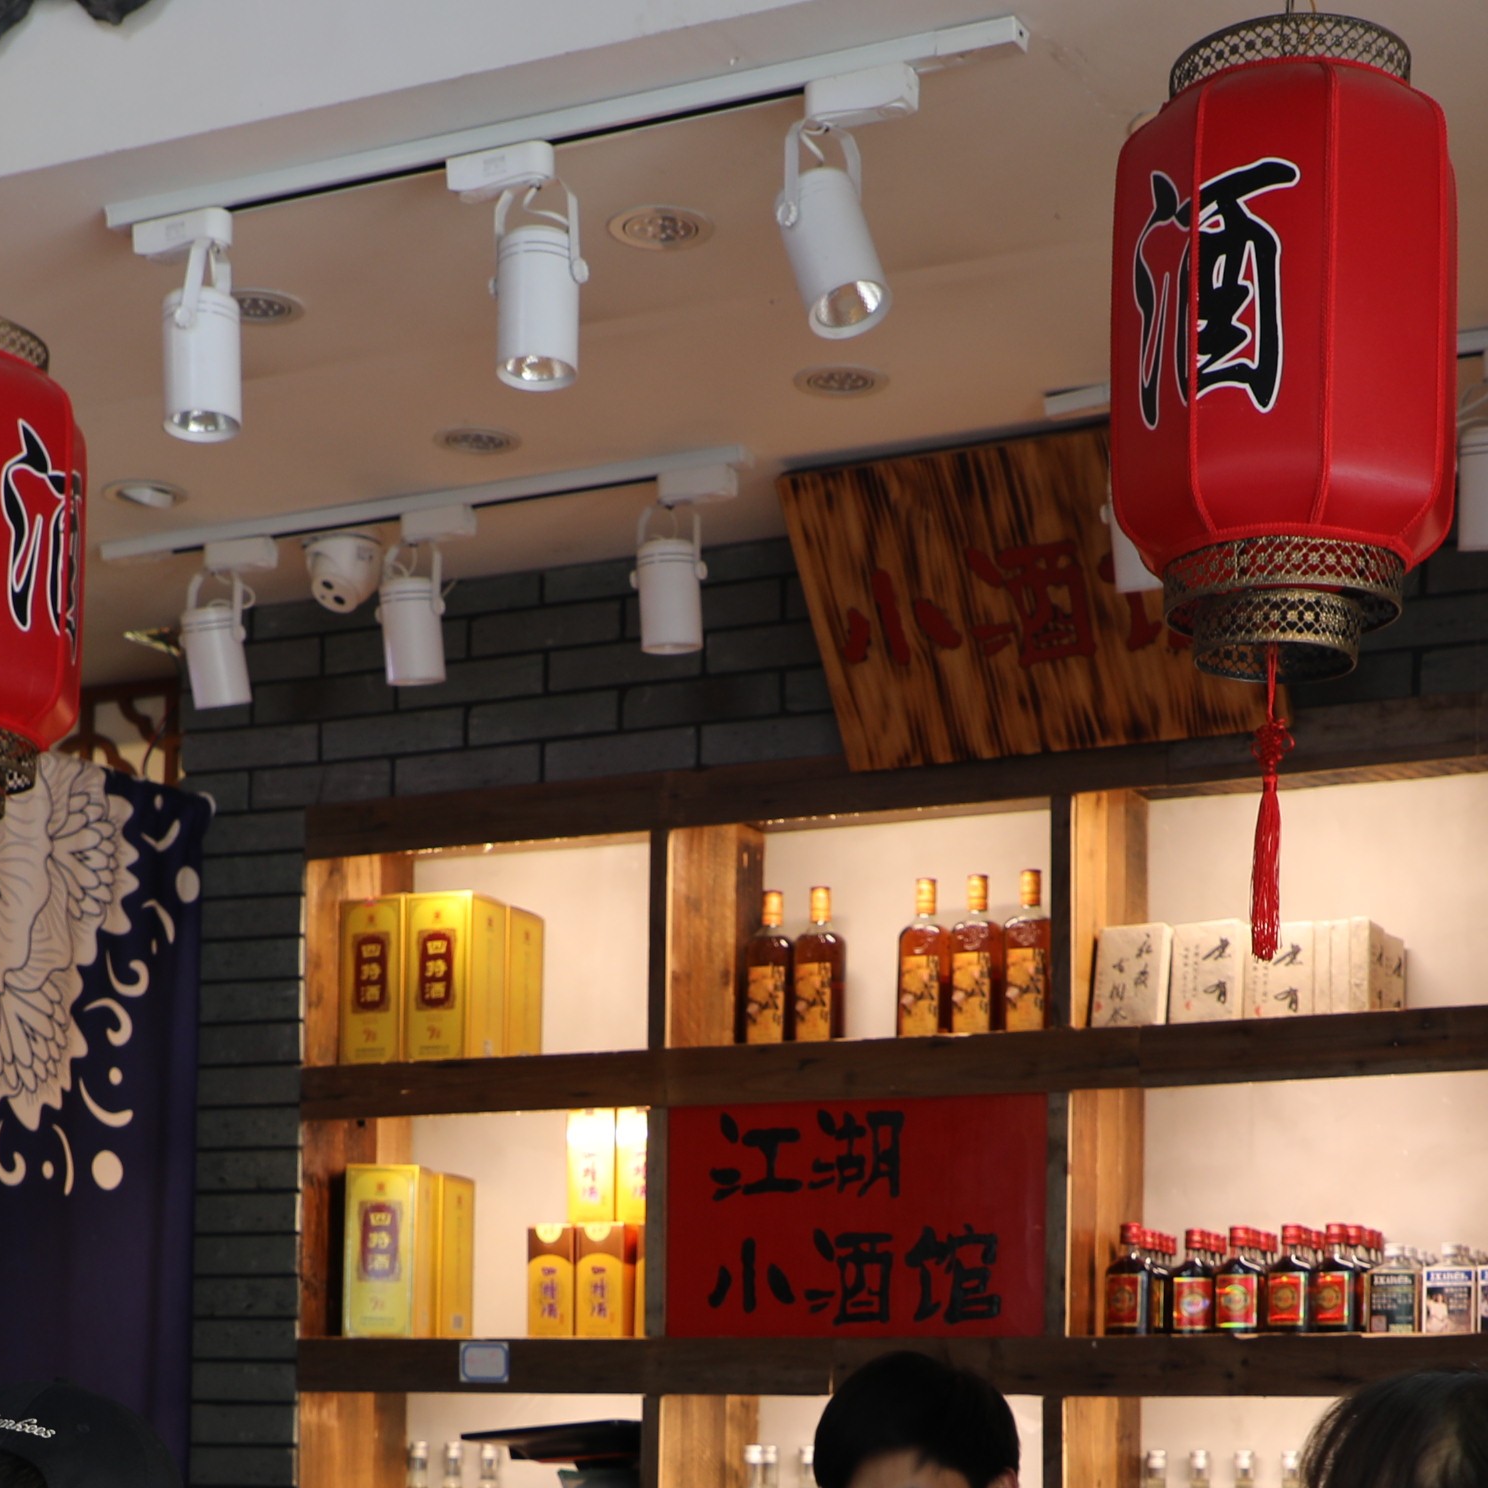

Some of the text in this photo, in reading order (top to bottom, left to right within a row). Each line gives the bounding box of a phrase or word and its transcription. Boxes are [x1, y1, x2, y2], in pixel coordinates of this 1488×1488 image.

[1134, 157, 1300, 430] 酒
[842, 537, 1194, 669] 小酒
[708, 1109, 906, 1199] 江湖
[707, 1223, 1005, 1327] 小酒馆
